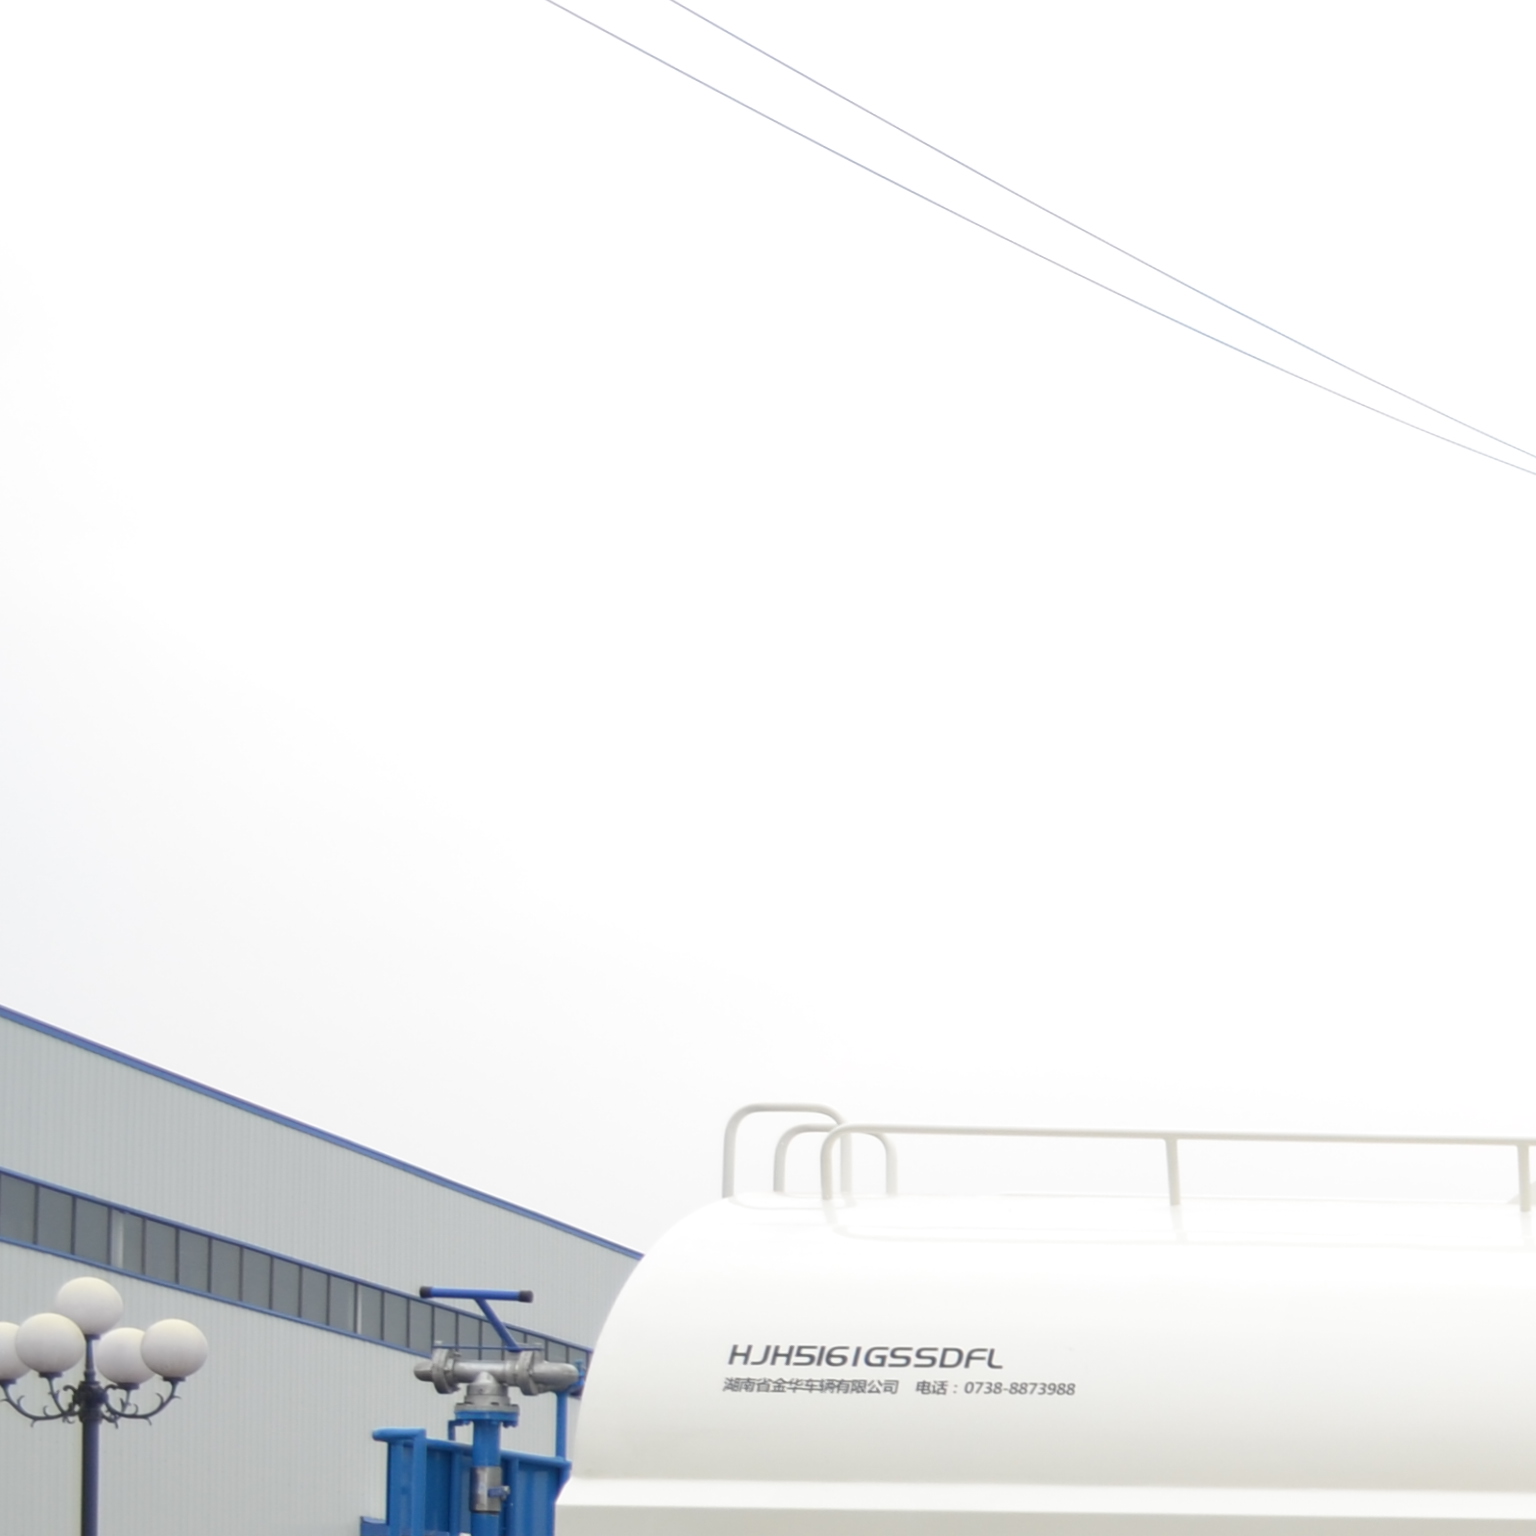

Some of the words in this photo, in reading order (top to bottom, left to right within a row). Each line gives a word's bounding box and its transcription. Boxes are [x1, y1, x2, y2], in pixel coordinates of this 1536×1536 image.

[722, 1377, 900, 1395] 湖南省金华车辆有限公司
